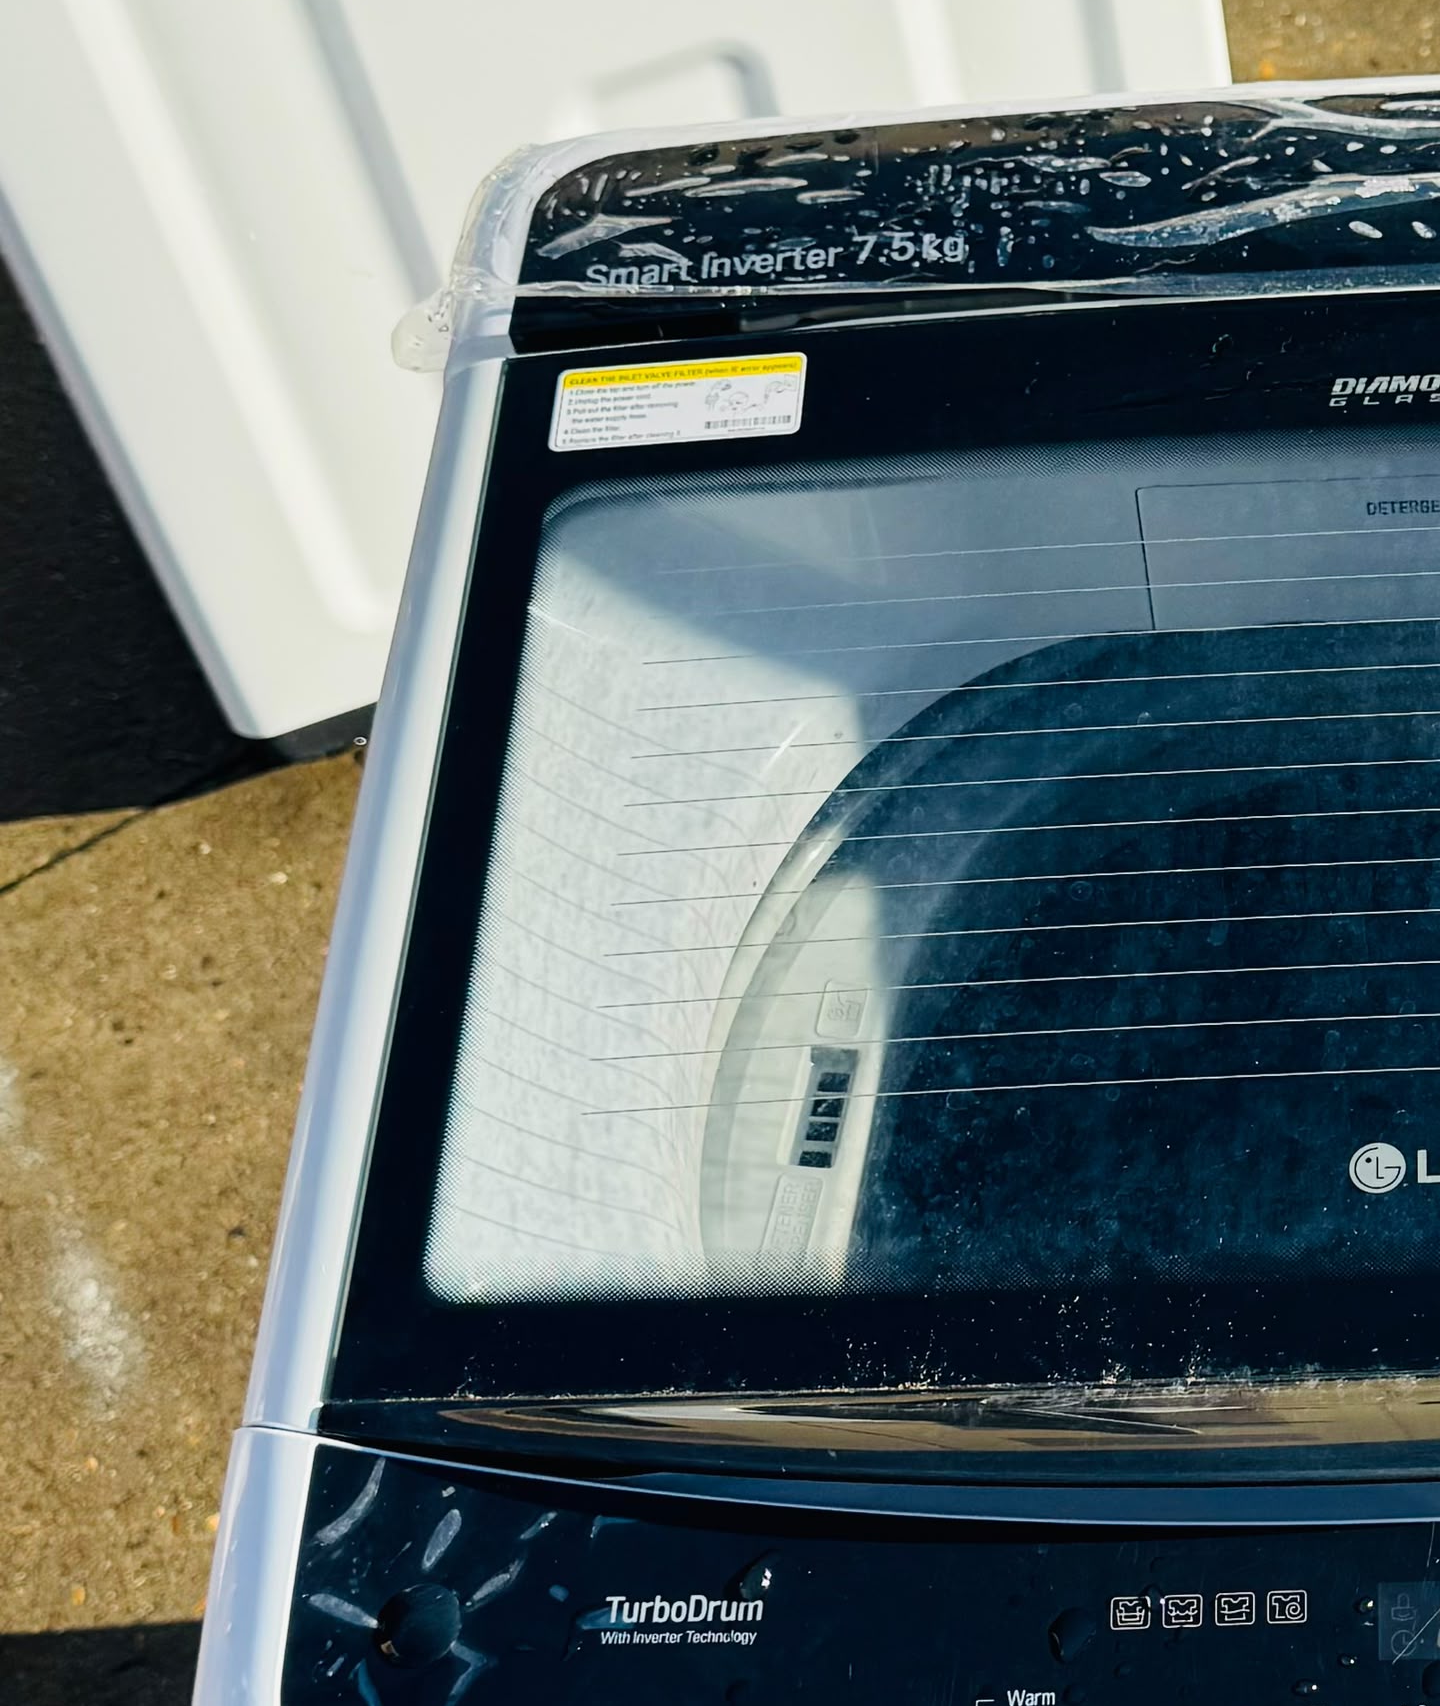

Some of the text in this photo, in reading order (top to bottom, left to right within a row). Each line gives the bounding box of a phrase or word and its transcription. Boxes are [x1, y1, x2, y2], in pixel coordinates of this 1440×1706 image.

[586, 259, 694, 286] Smart
[701, 245, 844, 280] Inverter
[605, 1594, 764, 1624] TurboDrum
[600, 1630, 758, 1646] With Inverter Technology
[1006, 1690, 1056, 1706] Warm
